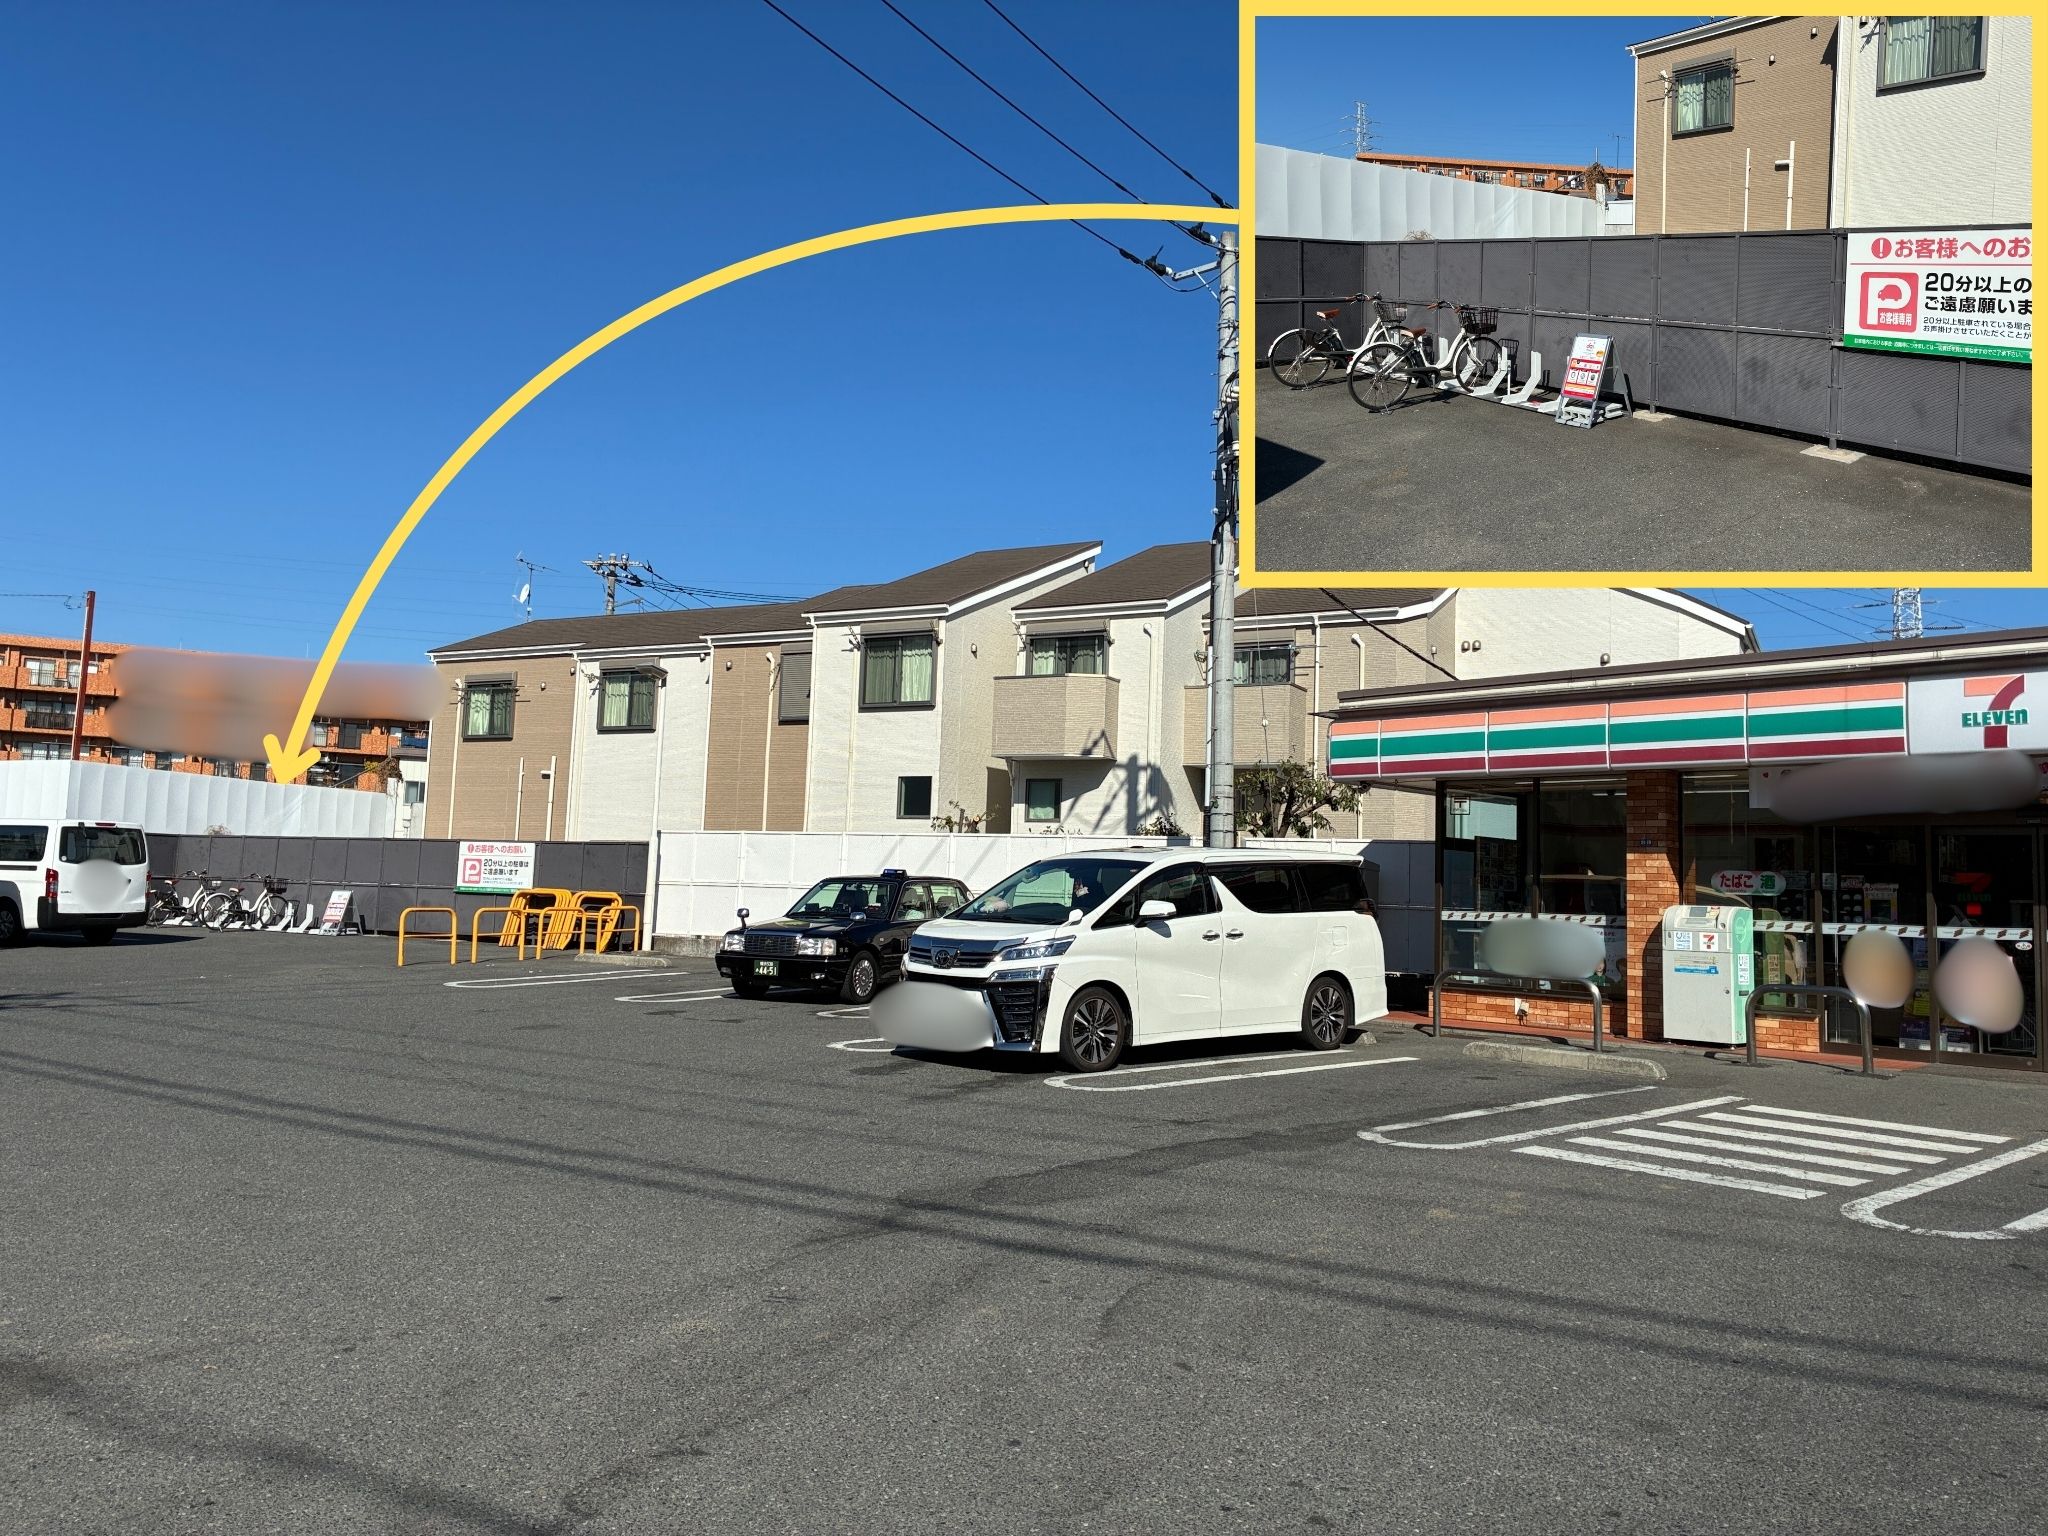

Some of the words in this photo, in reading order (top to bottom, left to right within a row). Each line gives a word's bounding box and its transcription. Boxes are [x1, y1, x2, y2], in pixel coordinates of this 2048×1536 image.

[1895, 237, 2032, 259] お客様へのお
[1925, 272, 2032, 293] 20分以上の
[1924, 296, 2032, 315] ご遠慮願いま
[1879, 312, 1912, 326] お客様専用
[475, 844, 527, 854] お客様へのお願い
[1720, 873, 1754, 888] たばこ
[1760, 874, 1775, 889] 酒
